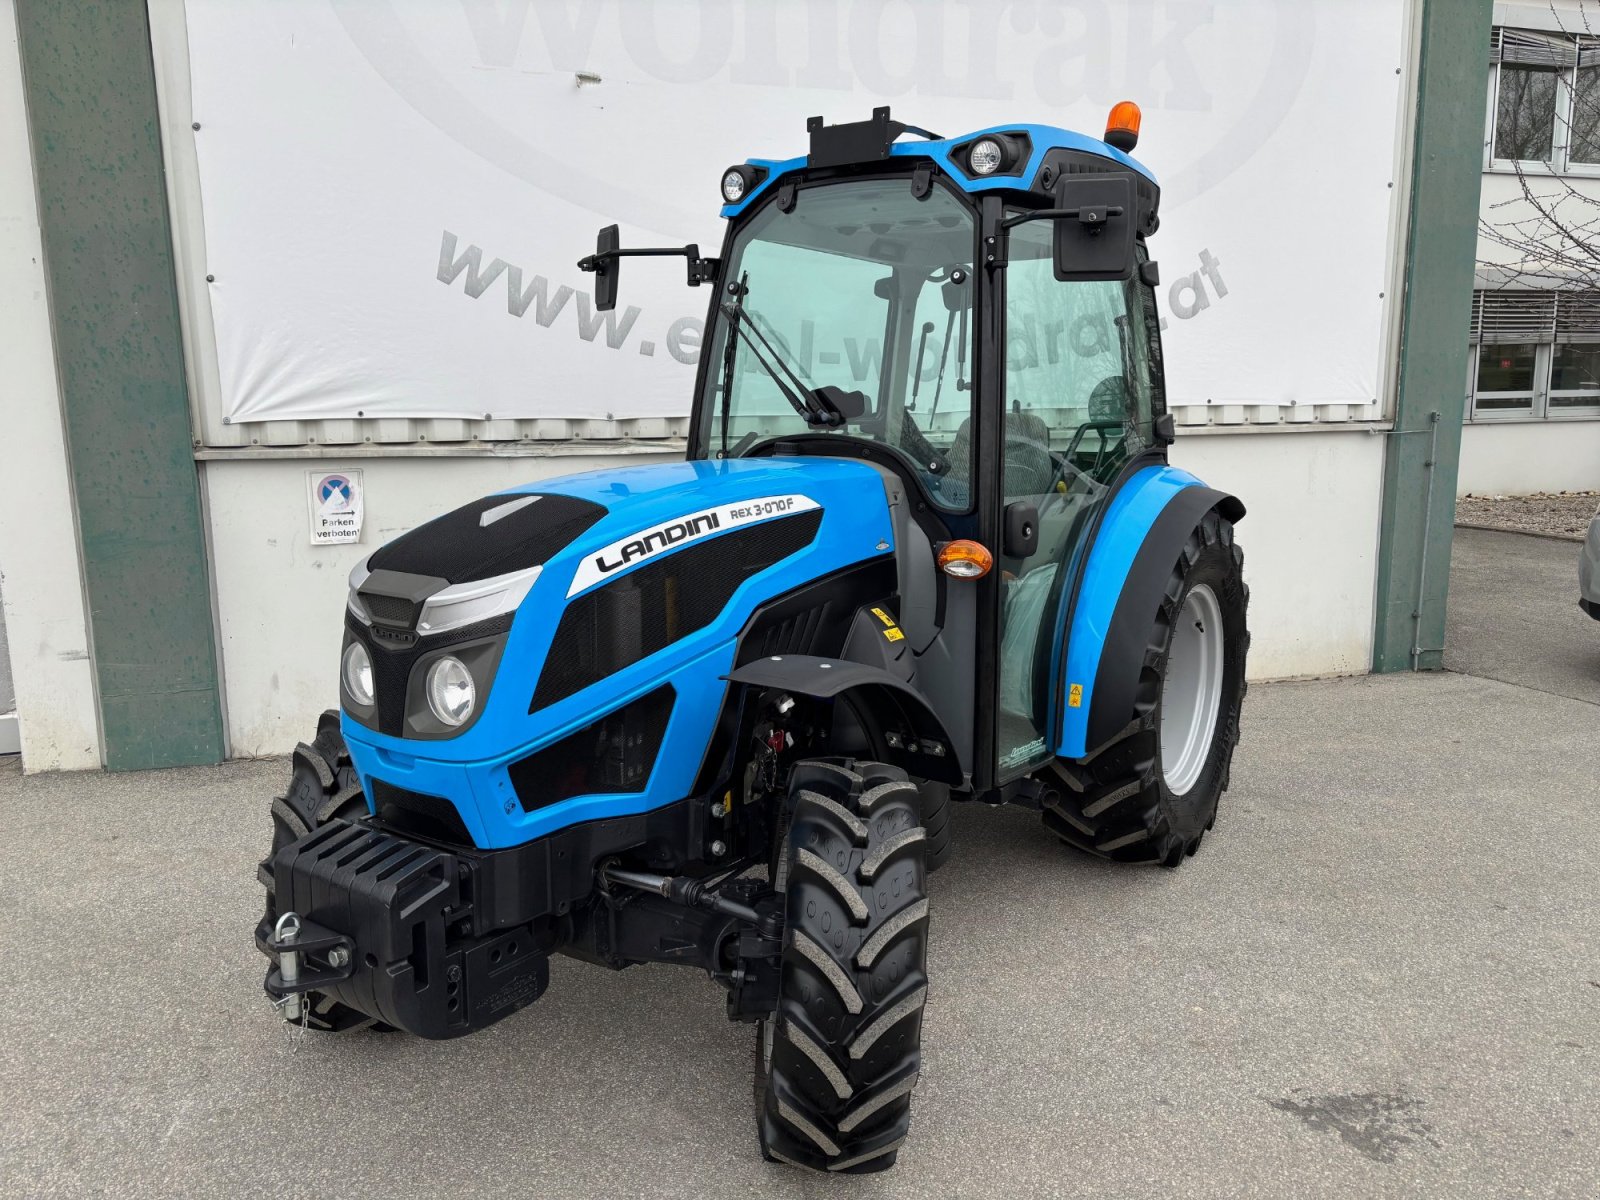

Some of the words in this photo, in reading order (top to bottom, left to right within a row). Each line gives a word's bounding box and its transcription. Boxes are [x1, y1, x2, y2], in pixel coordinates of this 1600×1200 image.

[322, 518, 354, 527] Parken
[595, 512, 720, 573] LANDINI
[729, 507, 753, 520] REX
